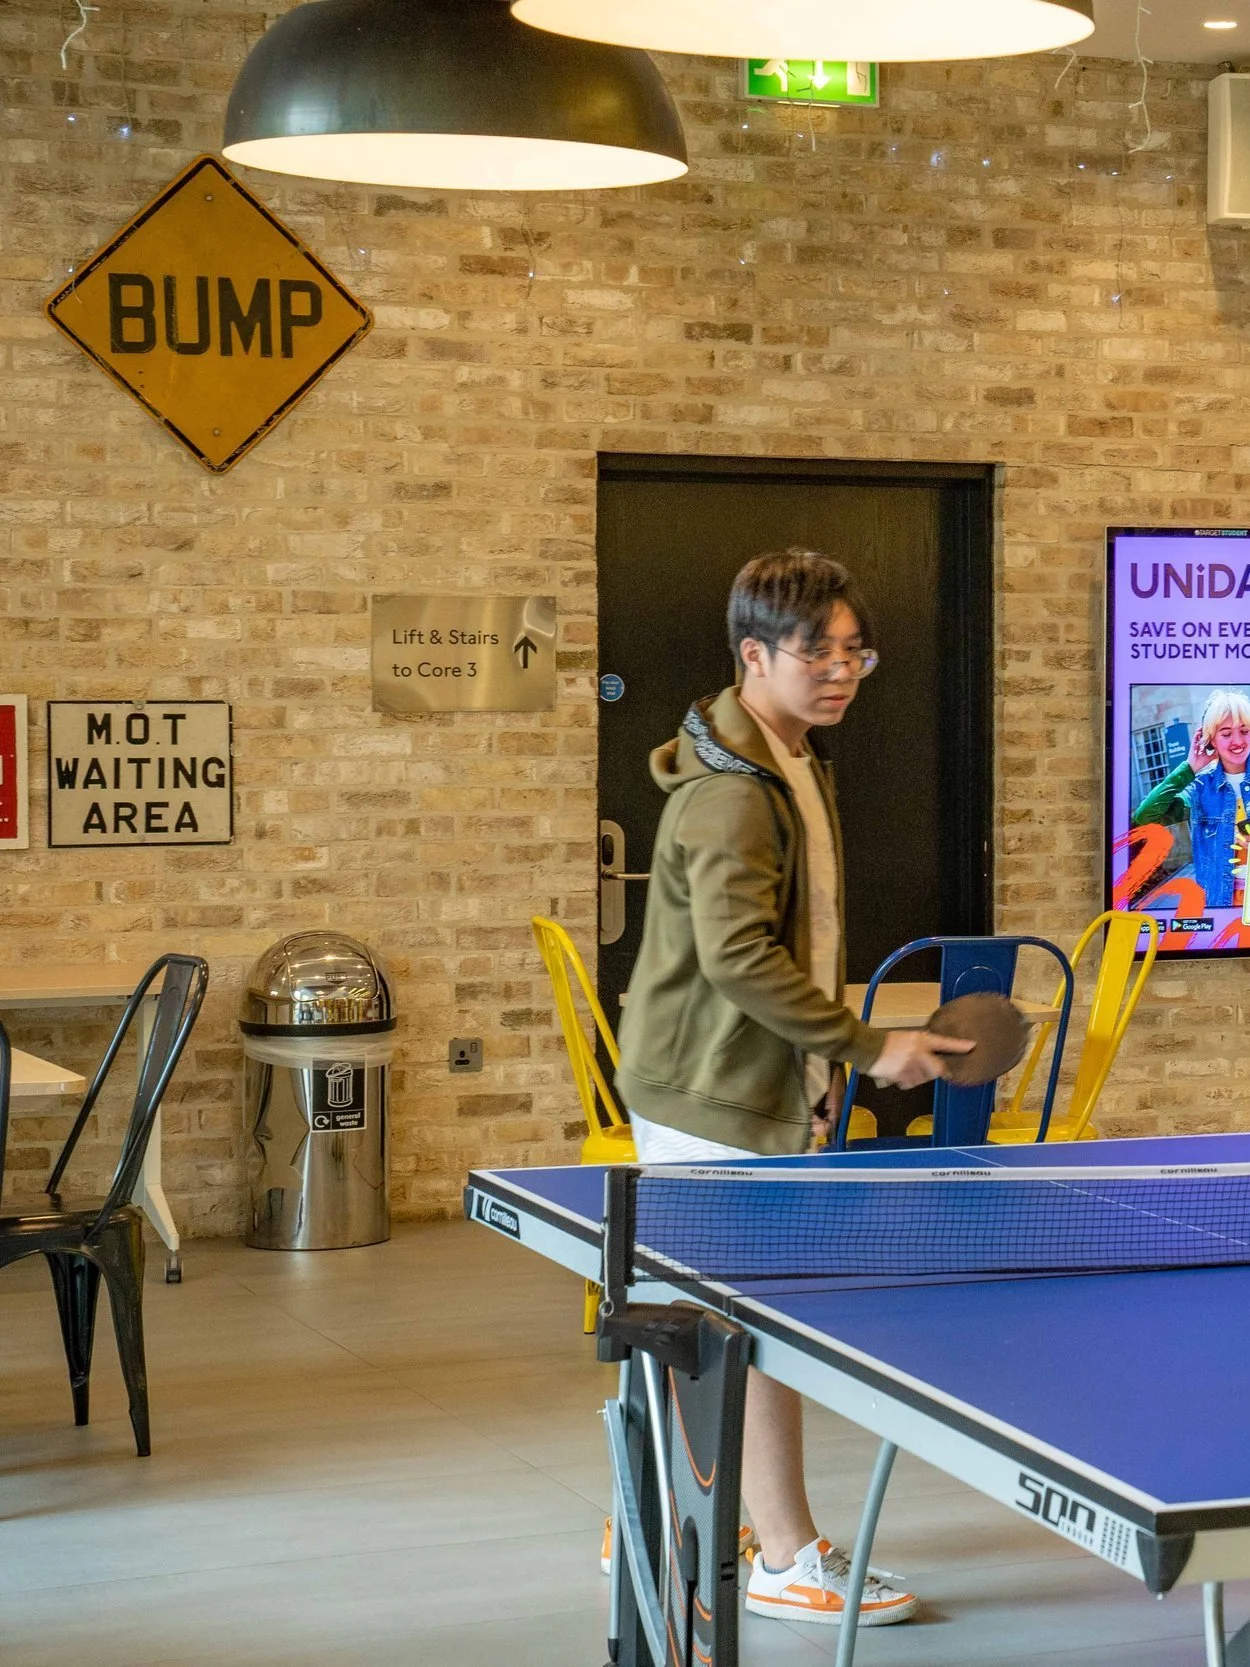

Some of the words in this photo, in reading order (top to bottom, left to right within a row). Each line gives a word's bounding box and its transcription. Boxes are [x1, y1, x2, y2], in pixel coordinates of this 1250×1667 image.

[108, 273, 323, 358] BUMP
[392, 629, 424, 645] Lift
[430, 629, 443, 645] &
[448, 629, 499, 645] Stairs
[1129, 621, 1177, 638] SAVE
[1182, 622, 1211, 638] ON
[1130, 643, 1220, 659] STUDENT
[392, 663, 412, 677] to
[417, 662, 462, 677] Core
[467, 662, 478, 677] 3
[86, 713, 186, 745] M.O.T
[54, 757, 226, 789] WAITING
[82, 801, 199, 834] AREA
[335, 1112, 361, 1121] general
